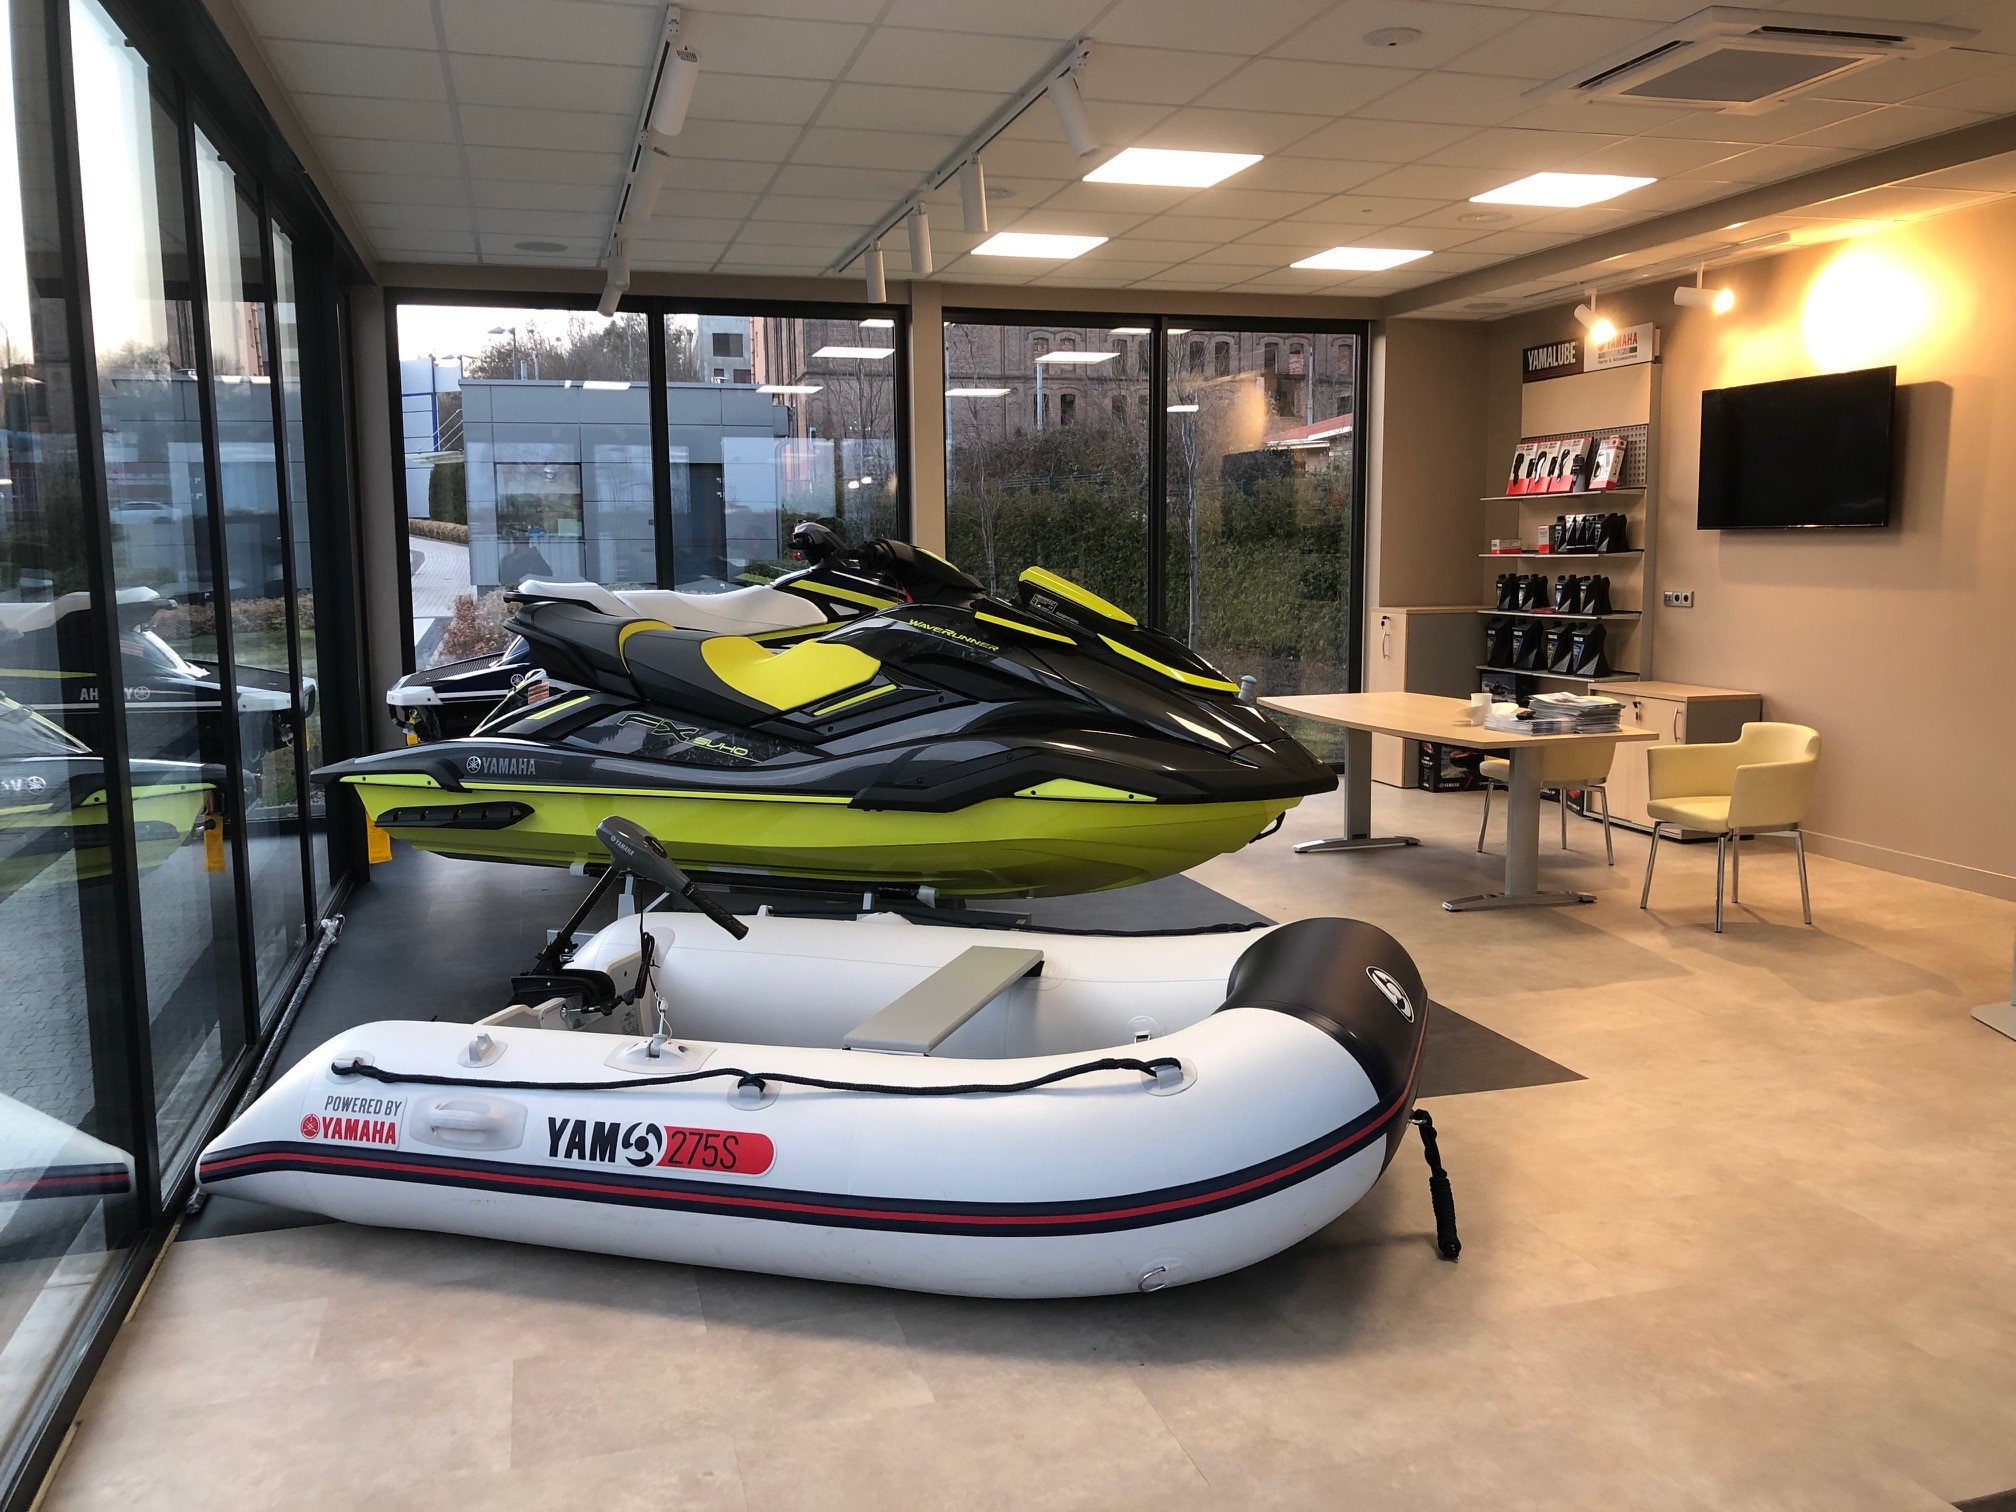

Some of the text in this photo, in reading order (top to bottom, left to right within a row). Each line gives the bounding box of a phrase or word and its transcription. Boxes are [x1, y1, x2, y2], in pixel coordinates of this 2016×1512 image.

[1527, 341, 1576, 371] YAMALUBE
[907, 619, 1000, 652] WAVERUNNER
[617, 712, 749, 756] FX SVHO
[482, 757, 536, 775] YAMAHA
[615, 838, 635, 857] YAMAHA
[324, 1095, 403, 1117] POWERED BY
[321, 1116, 397, 1145] YAMAHA
[547, 1116, 740, 1170] YAM 275S
